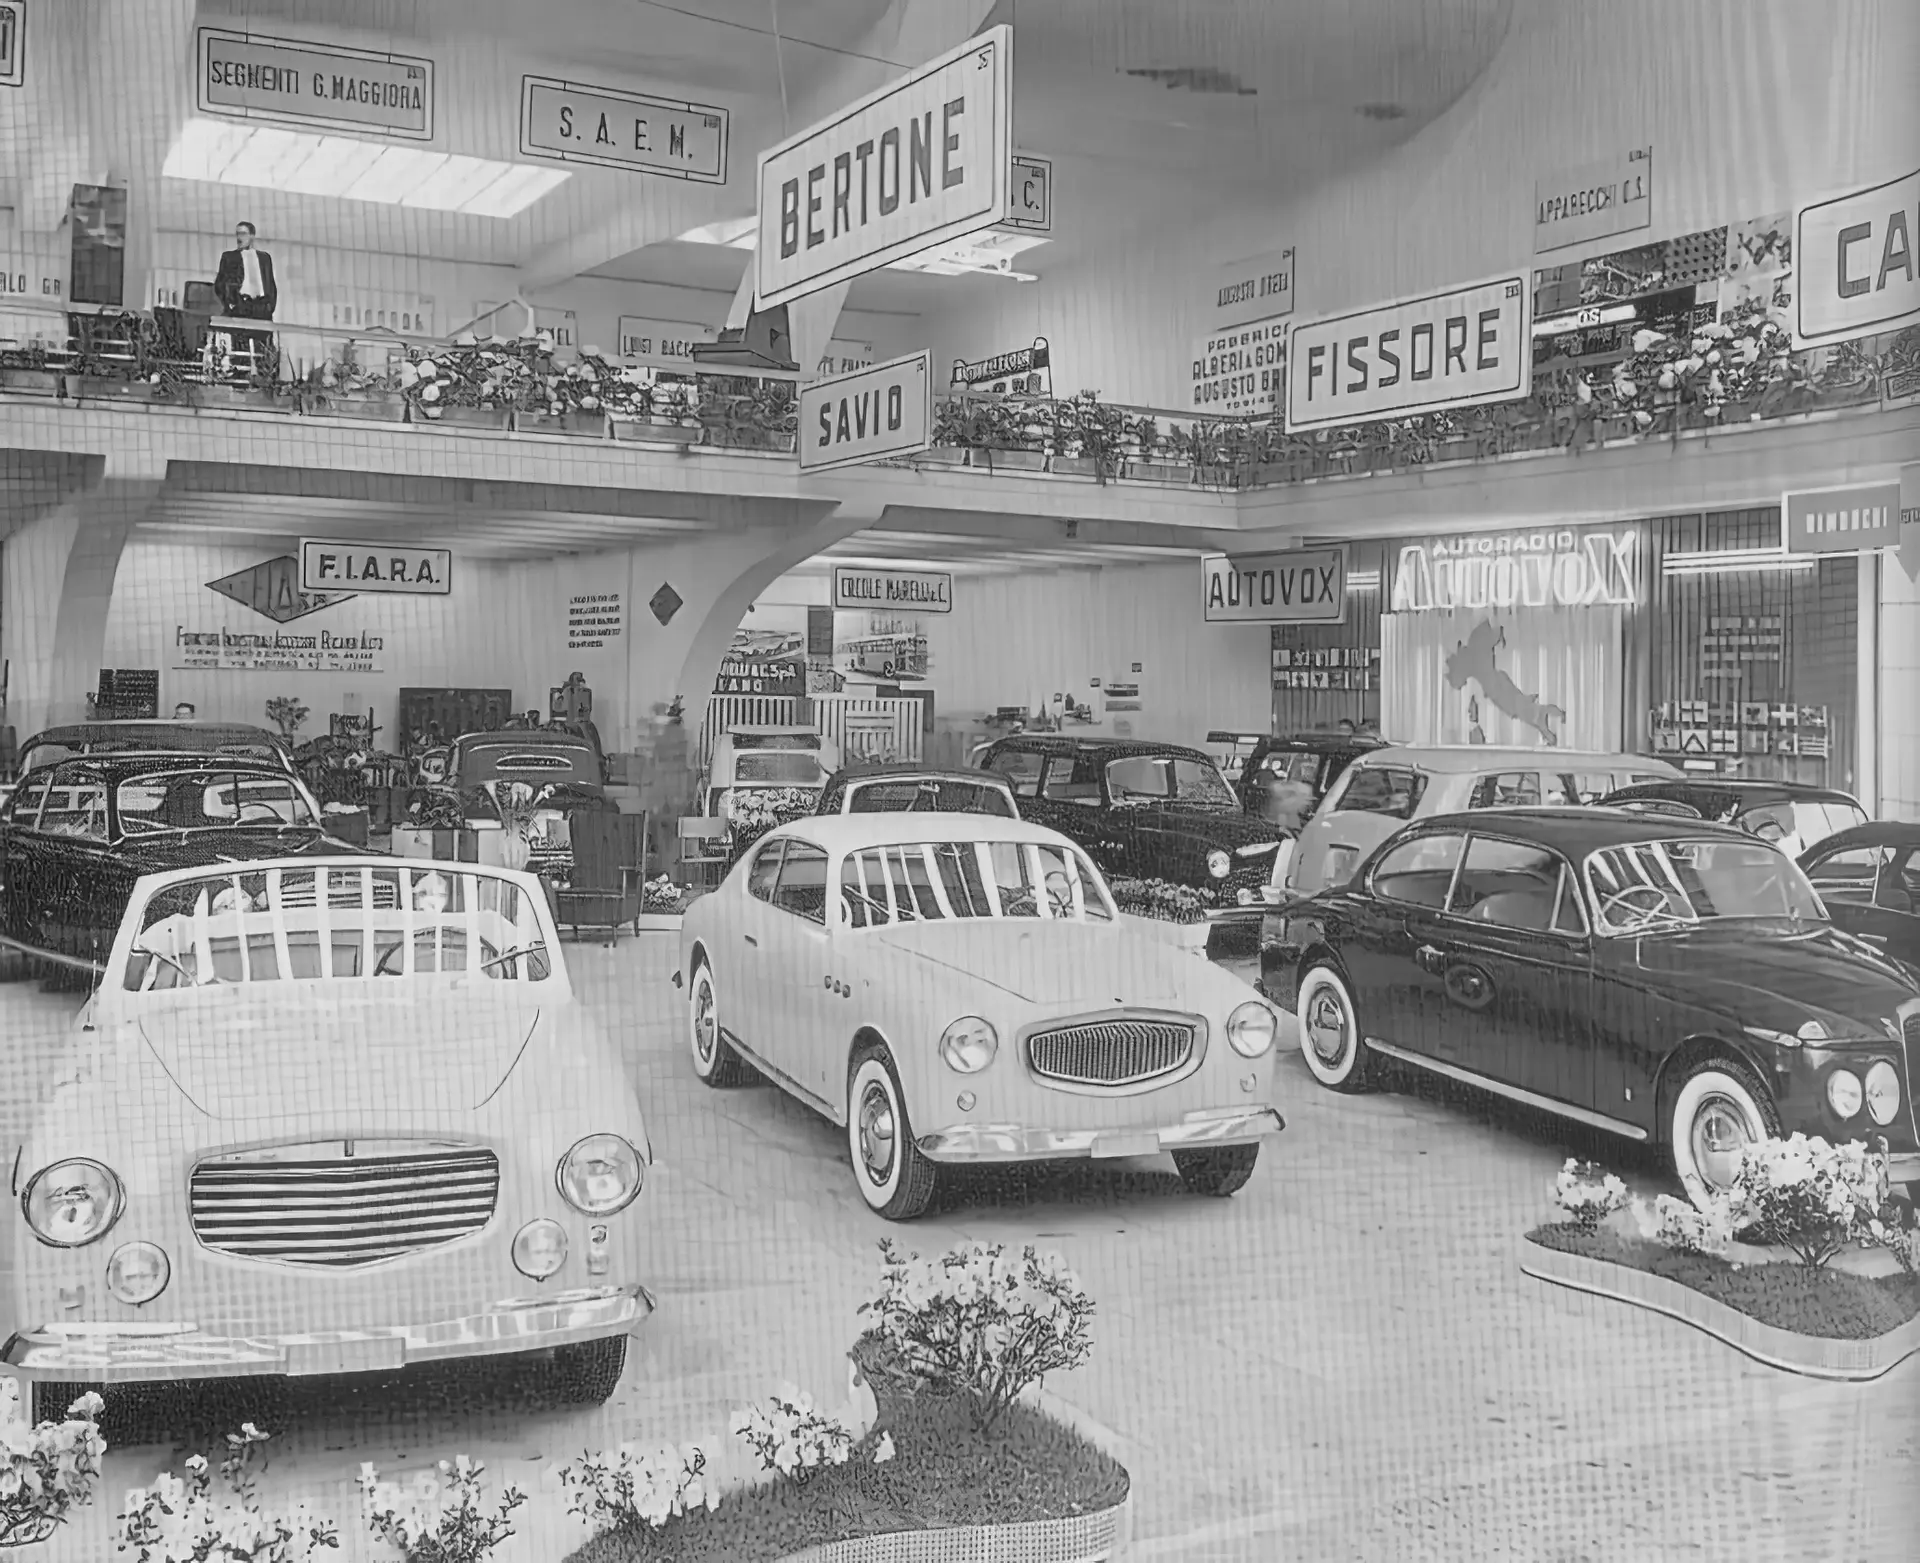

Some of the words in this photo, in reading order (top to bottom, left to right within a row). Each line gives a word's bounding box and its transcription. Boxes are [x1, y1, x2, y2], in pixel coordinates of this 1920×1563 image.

[780, 96, 965, 260] BERTONE
[1837, 201, 1920, 299] CA
[1308, 307, 1500, 401] FISSORE
[818, 384, 903, 448] SAVIO
[318, 553, 441, 585] F.I.A.R.A.
[1432, 531, 1574, 557] AUTORADIO
[1208, 566, 1335, 608] AUTOVOX
